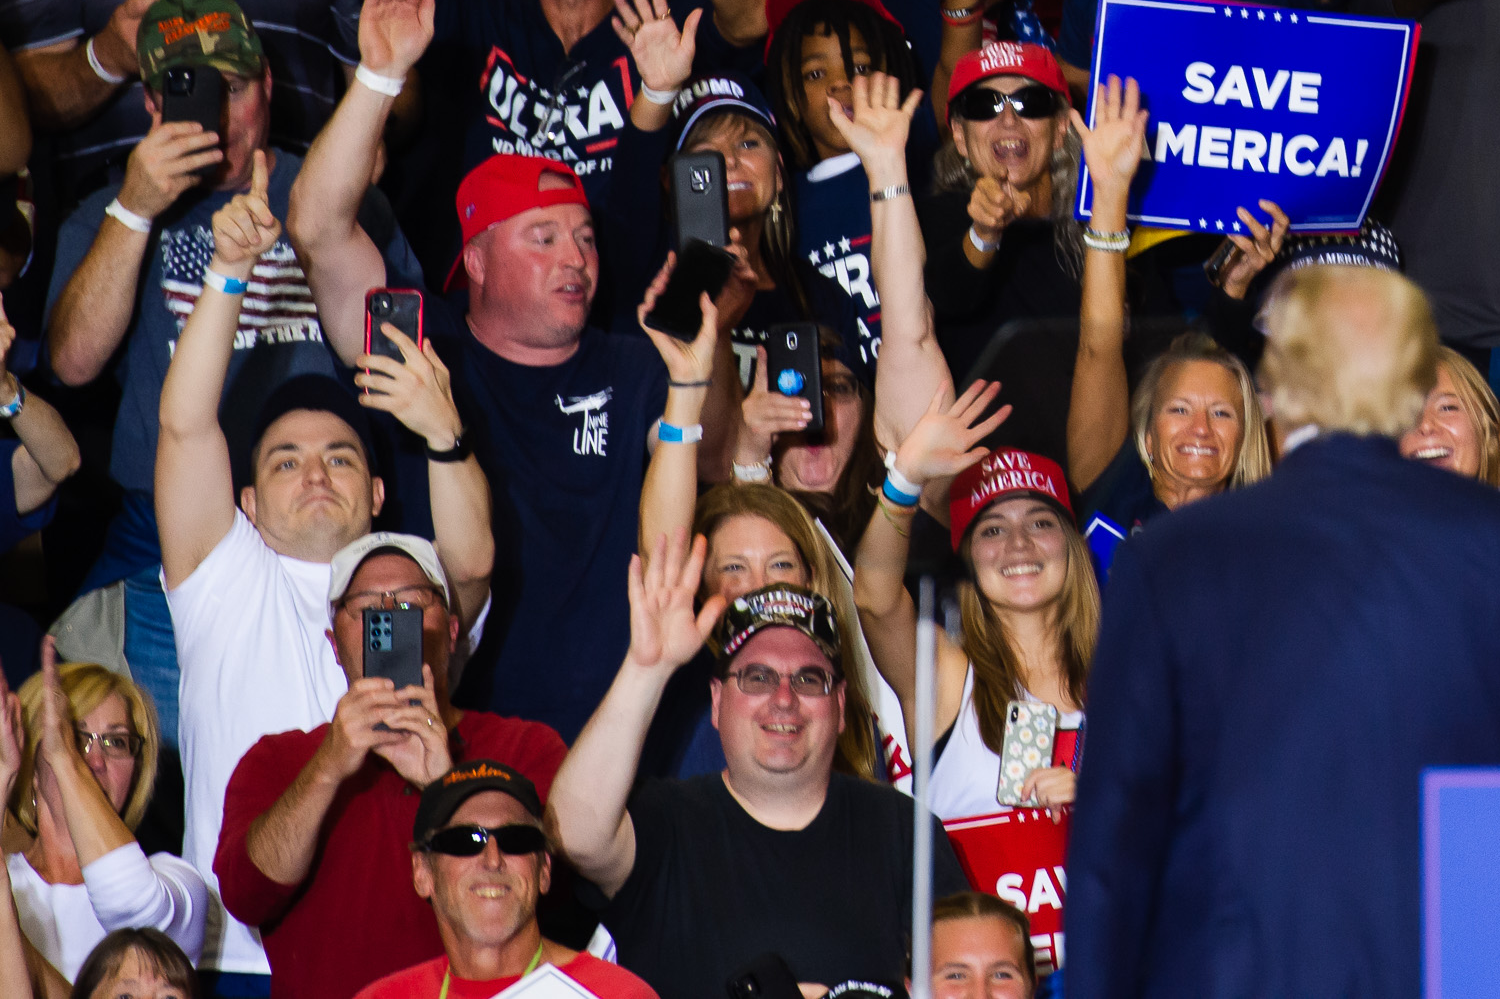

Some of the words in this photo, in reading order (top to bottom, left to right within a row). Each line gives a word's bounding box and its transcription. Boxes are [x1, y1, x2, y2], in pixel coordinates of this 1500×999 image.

[489, 65, 625, 149] ULTRA
[672, 78, 744, 120] TRUMP
[1181, 62, 1322, 115] SAVE
[574, 159, 597, 176] OF
[1147, 121, 1369, 178] MERICA!
[1317, 252, 1372, 268] AMERICA
[261, 323, 307, 345] THE
[573, 408, 609, 457] LINE
[588, 411, 609, 430] NINE
[981, 451, 1032, 477] SAVE
[970, 469, 1058, 508] AMERICA
